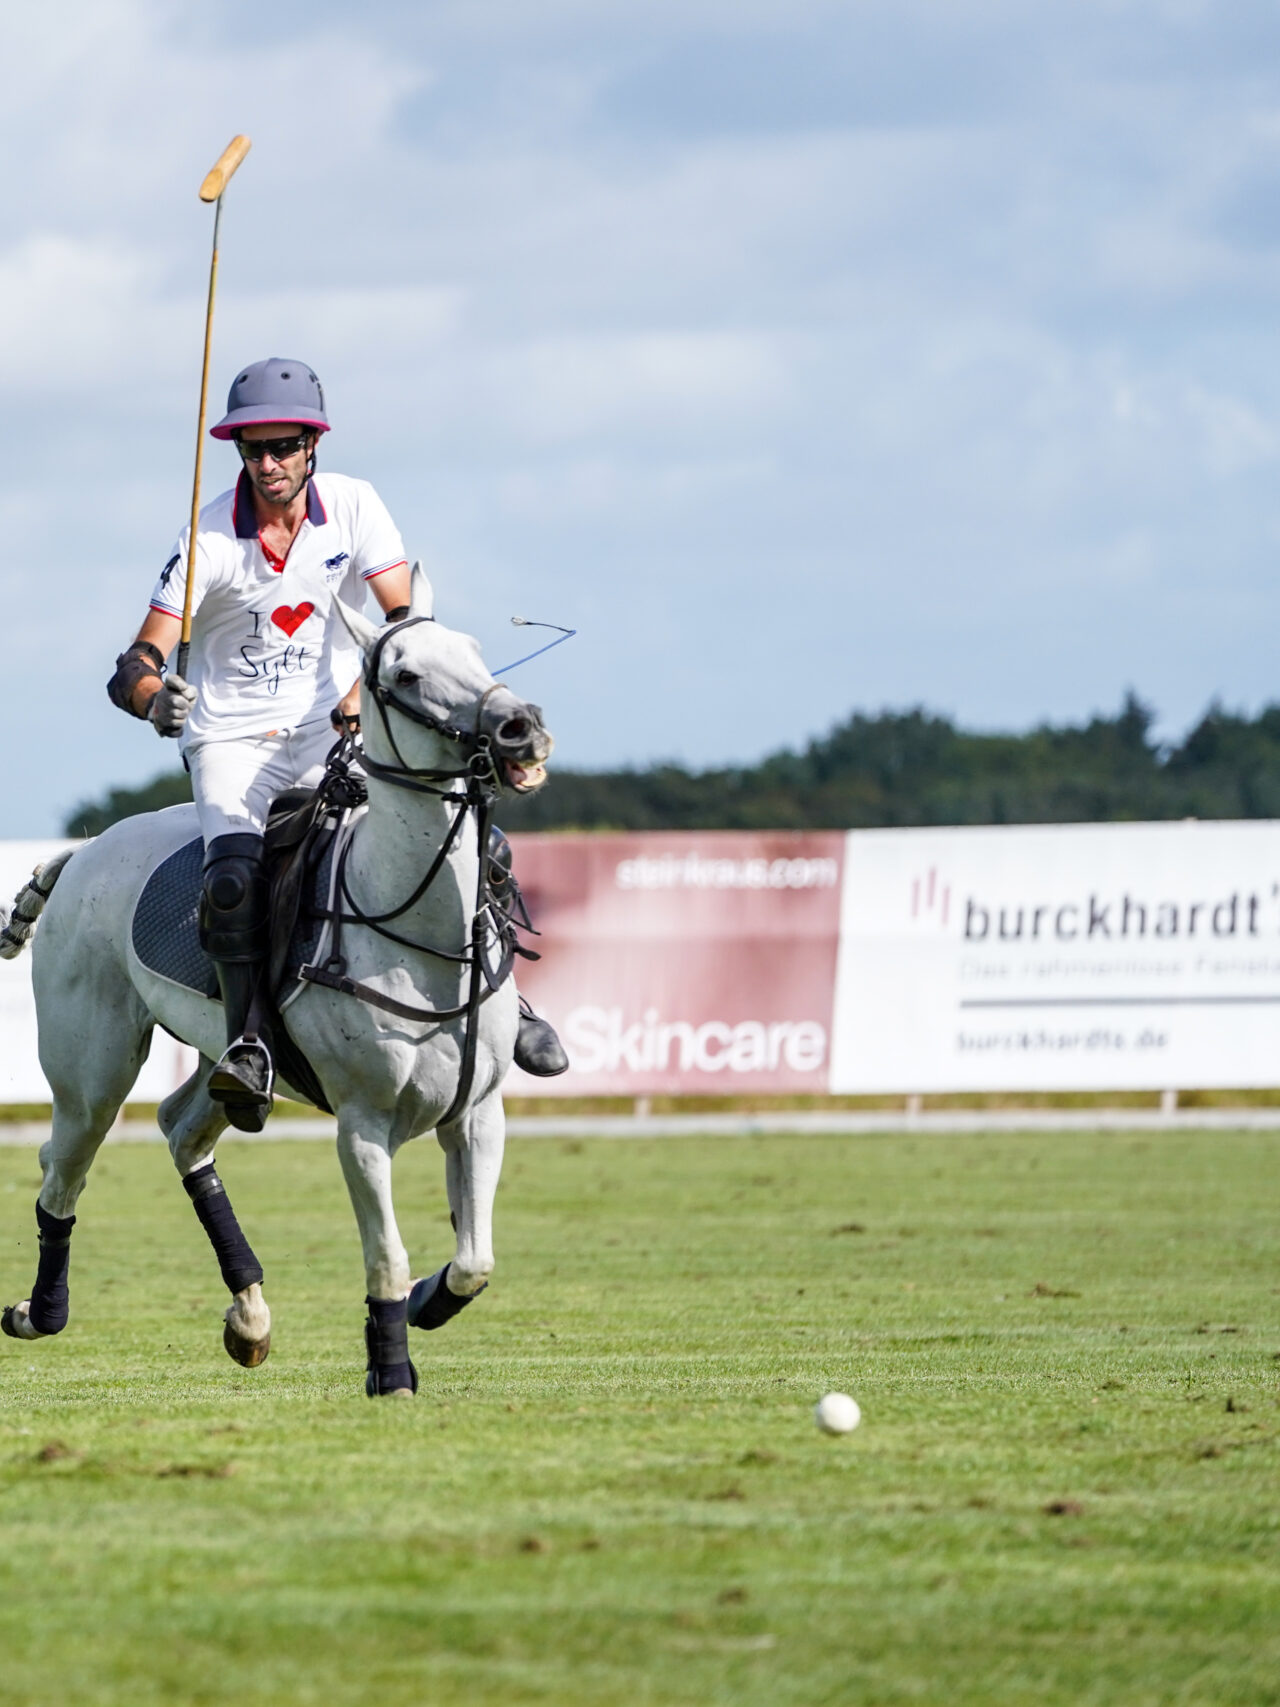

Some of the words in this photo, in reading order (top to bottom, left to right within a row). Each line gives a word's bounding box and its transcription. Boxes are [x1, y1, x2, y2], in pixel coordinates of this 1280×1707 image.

[160, 553, 181, 590] 4
[246, 610, 267, 639] I
[238, 644, 314, 695] Sylt
[563, 1004, 827, 1073] Skincare
